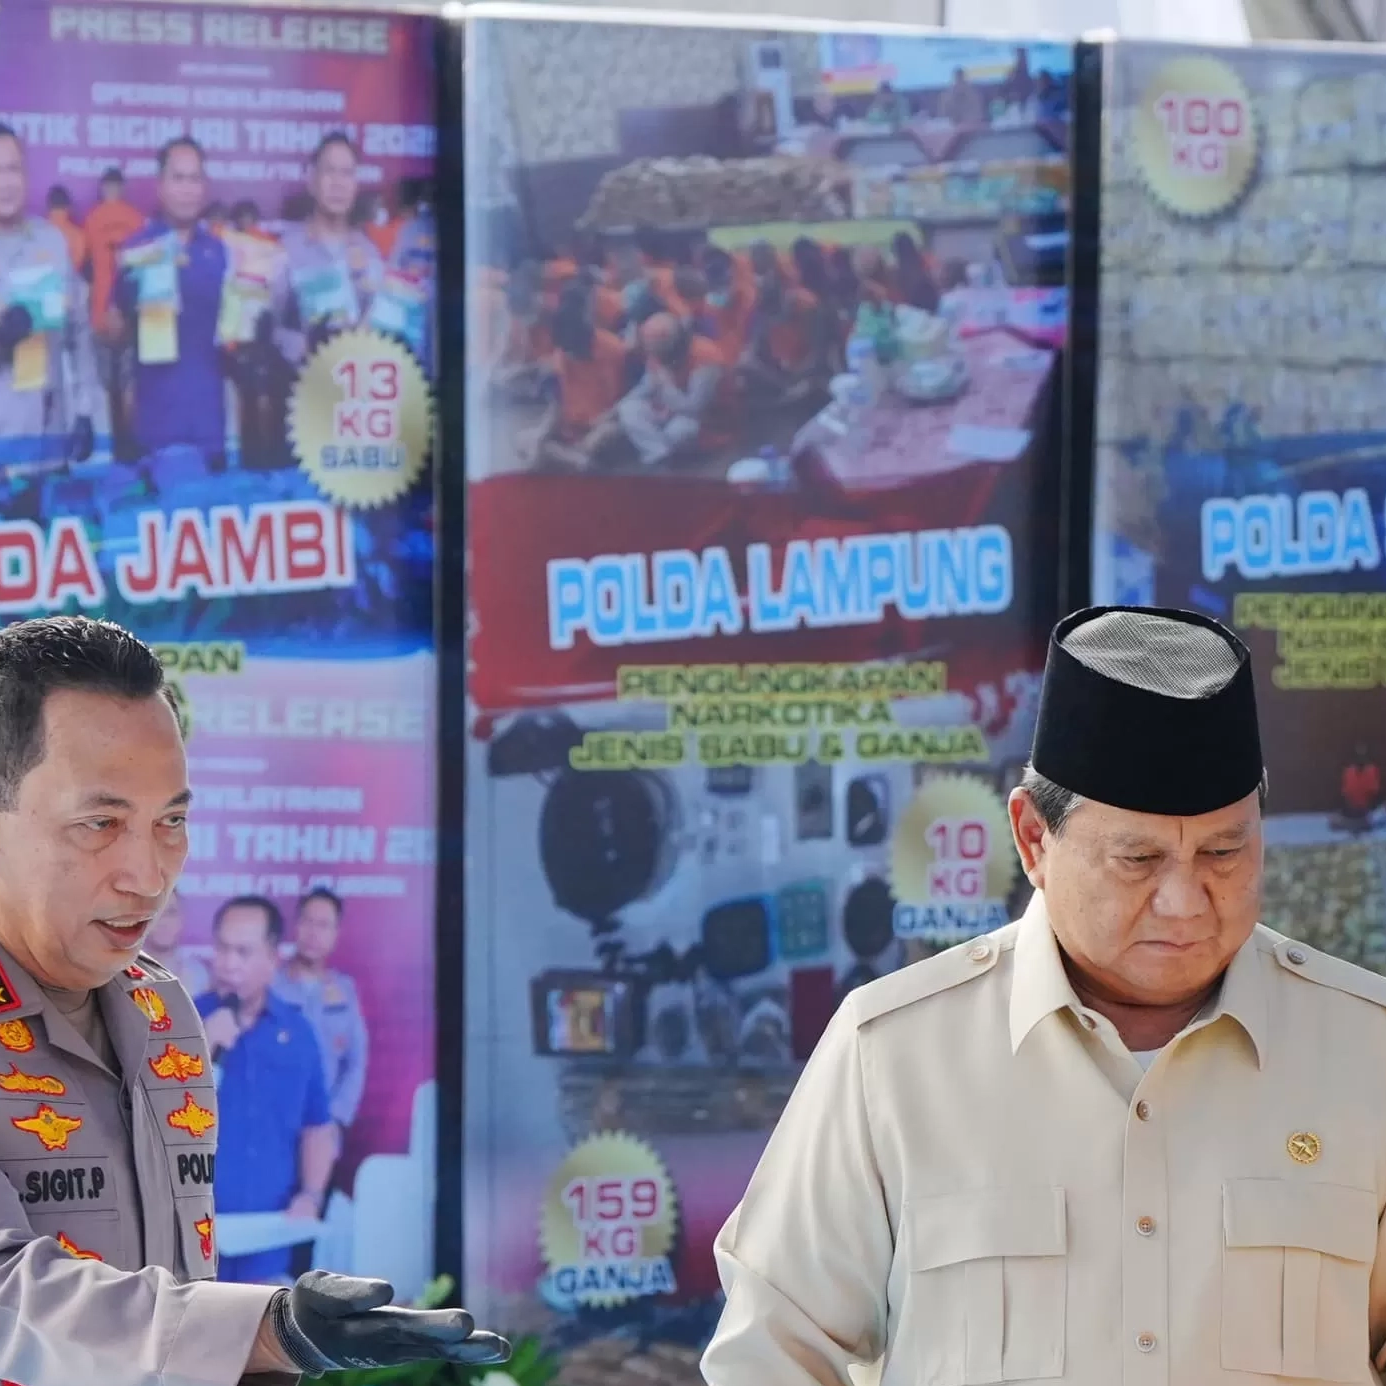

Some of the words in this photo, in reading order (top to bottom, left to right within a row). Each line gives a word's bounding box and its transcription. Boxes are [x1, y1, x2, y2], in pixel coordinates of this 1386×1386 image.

[49, 6, 193, 46] PRESS
[202, 11, 390, 55] RELEASE
[1162, 98, 1243, 136] 100
[338, 360, 399, 402] 13
[338, 407, 393, 439] KG
[320, 444, 403, 470] SABU
[123, 505, 349, 596] JAMBI
[1205, 492, 1376, 579] POLDA
[551, 549, 739, 647] POLDA
[751, 526, 1010, 632] LAMPUNG
[619, 665, 941, 696] PENGUNGKAPAN
[669, 699, 893, 728] NARKOTIKA
[573, 735, 685, 764] JENIS
[700, 733, 807, 763] SABU
[818, 734, 845, 761] &
[856, 730, 984, 758] GANJA
[931, 822, 986, 860] 10
[931, 868, 980, 897] KG
[895, 905, 1004, 931] GANJA
[568, 1181, 658, 1220] 159
[585, 1227, 636, 1257] KG
[555, 1264, 669, 1294] GANJA
